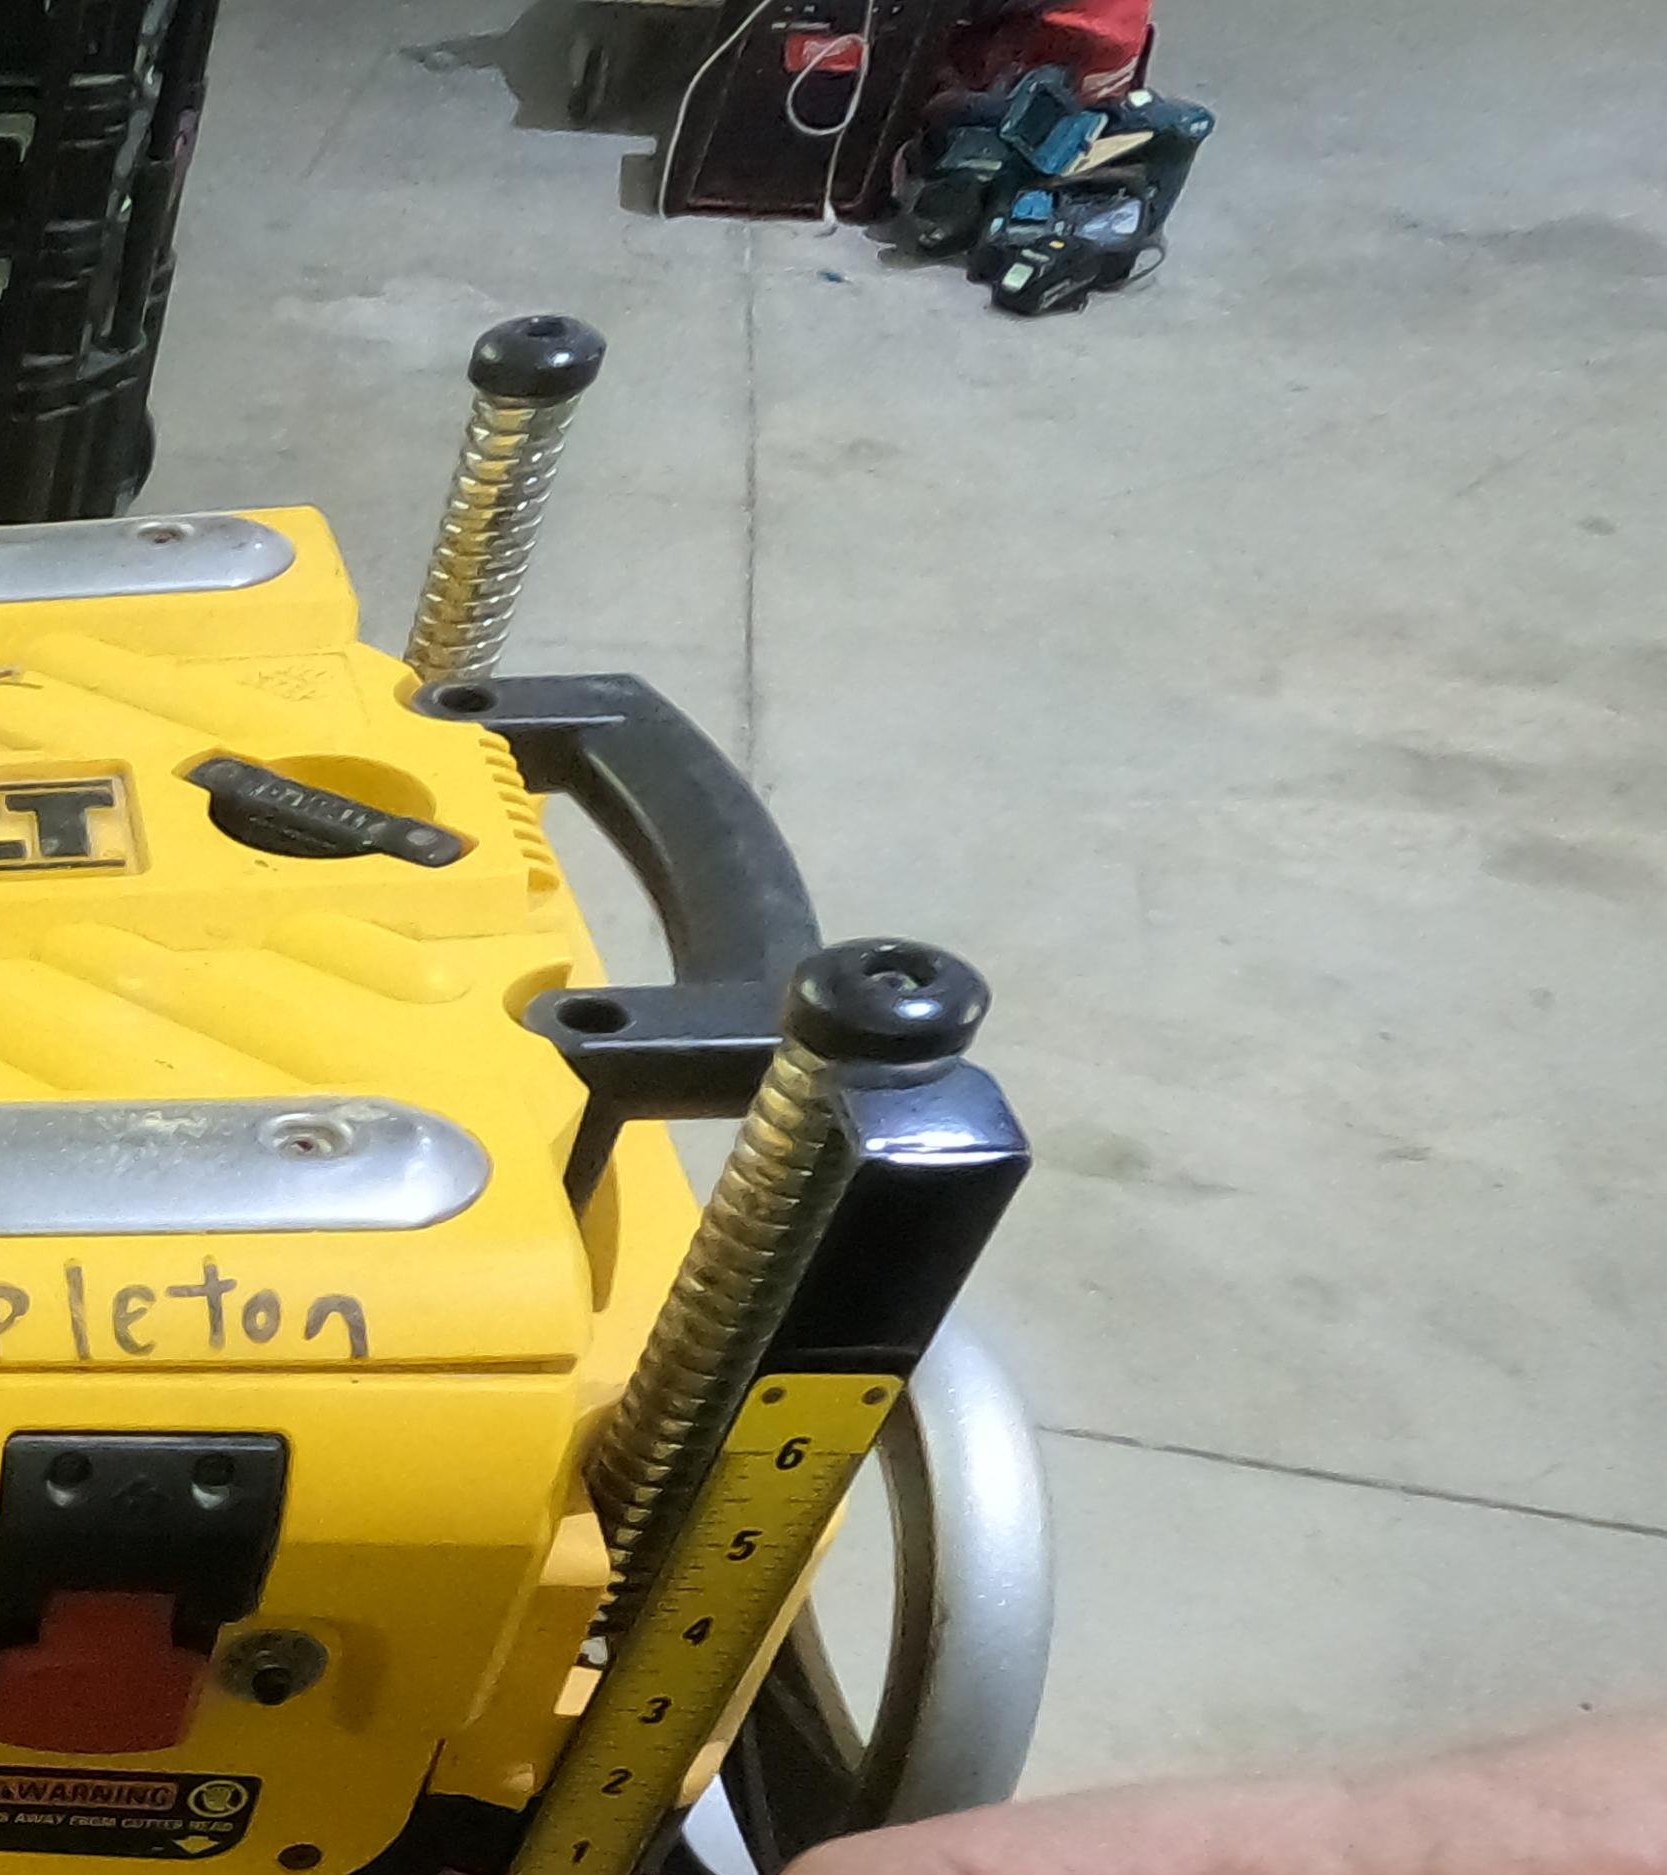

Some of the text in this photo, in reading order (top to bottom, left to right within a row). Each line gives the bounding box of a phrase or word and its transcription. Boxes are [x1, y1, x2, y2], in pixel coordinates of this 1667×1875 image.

[774, 1436, 812, 1471] 6
[724, 1529, 763, 1563] 5
[681, 1615, 713, 1647] 4
[639, 1695, 673, 1725] 3
[17, 1782, 175, 1808] WARNING
[600, 1767, 633, 1796] 2
[14, 1813, 66, 1826] AWAY
[69, 1814, 117, 1827] FROM
[121, 1817, 184, 1830] CUTTER
[188, 1820, 234, 1833] HEAD
[569, 1839, 591, 1864] 1
